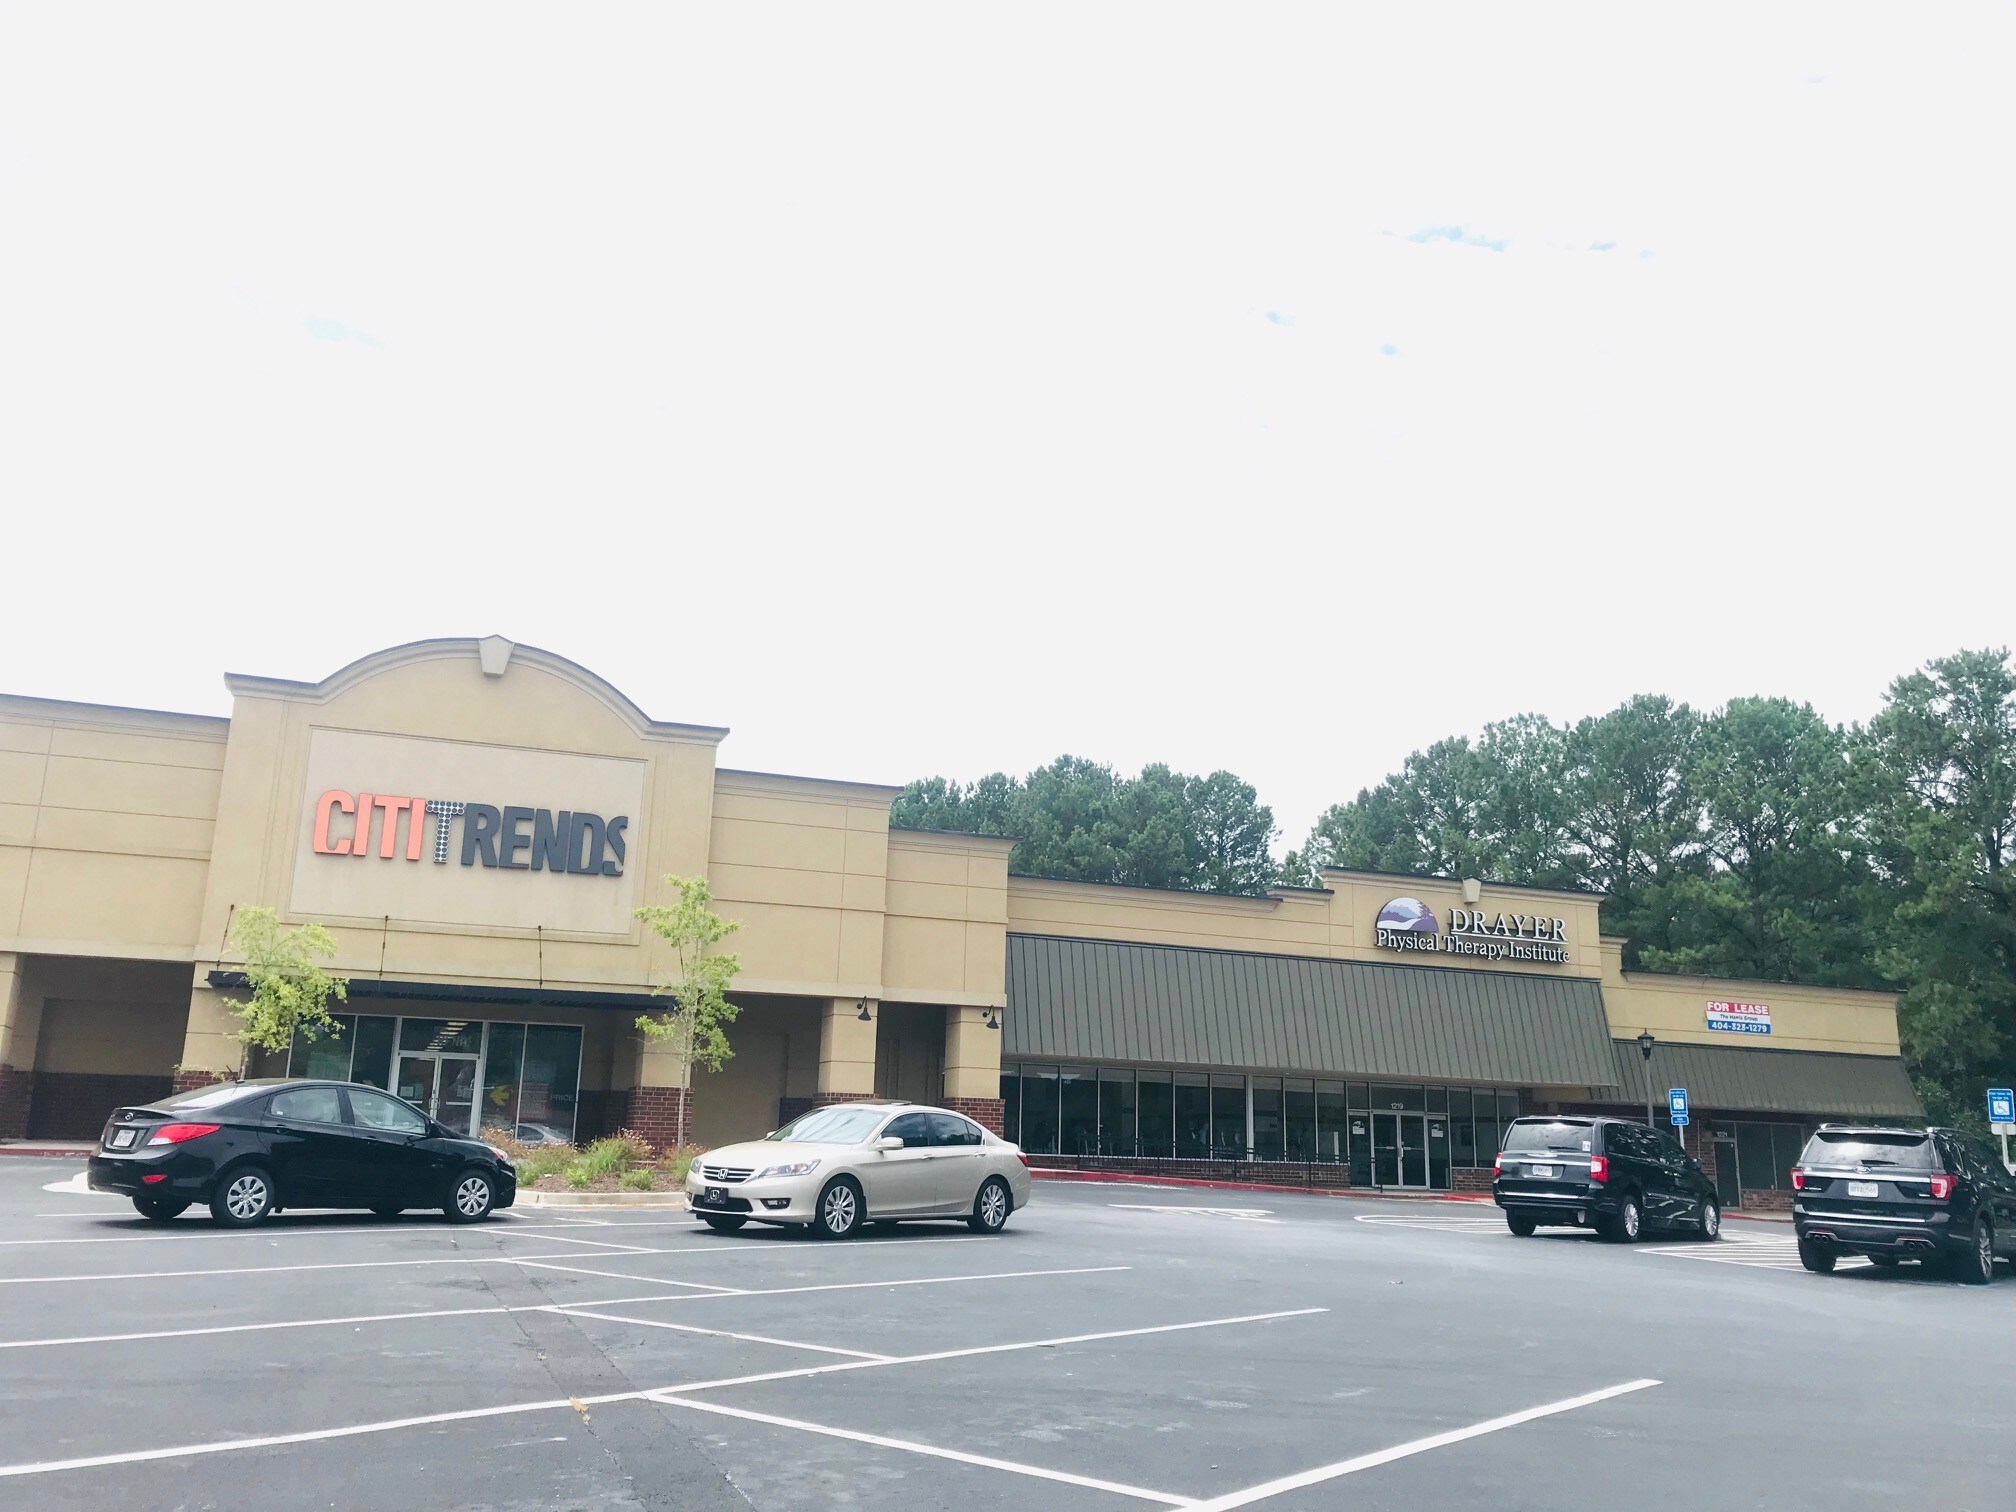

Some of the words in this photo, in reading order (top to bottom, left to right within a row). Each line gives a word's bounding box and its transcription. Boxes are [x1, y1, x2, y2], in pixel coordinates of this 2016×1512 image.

[1449, 908, 1568, 941] DRAYER
[1376, 929, 1439, 952] Physical
[1442, 935, 1506, 960] Therapy
[1508, 941, 1570, 963] Institute
[1707, 1001, 1729, 1011] FOR
[1734, 1003, 1768, 1014] LEASE
[1712, 1022, 1768, 1032] 404-323-1279
